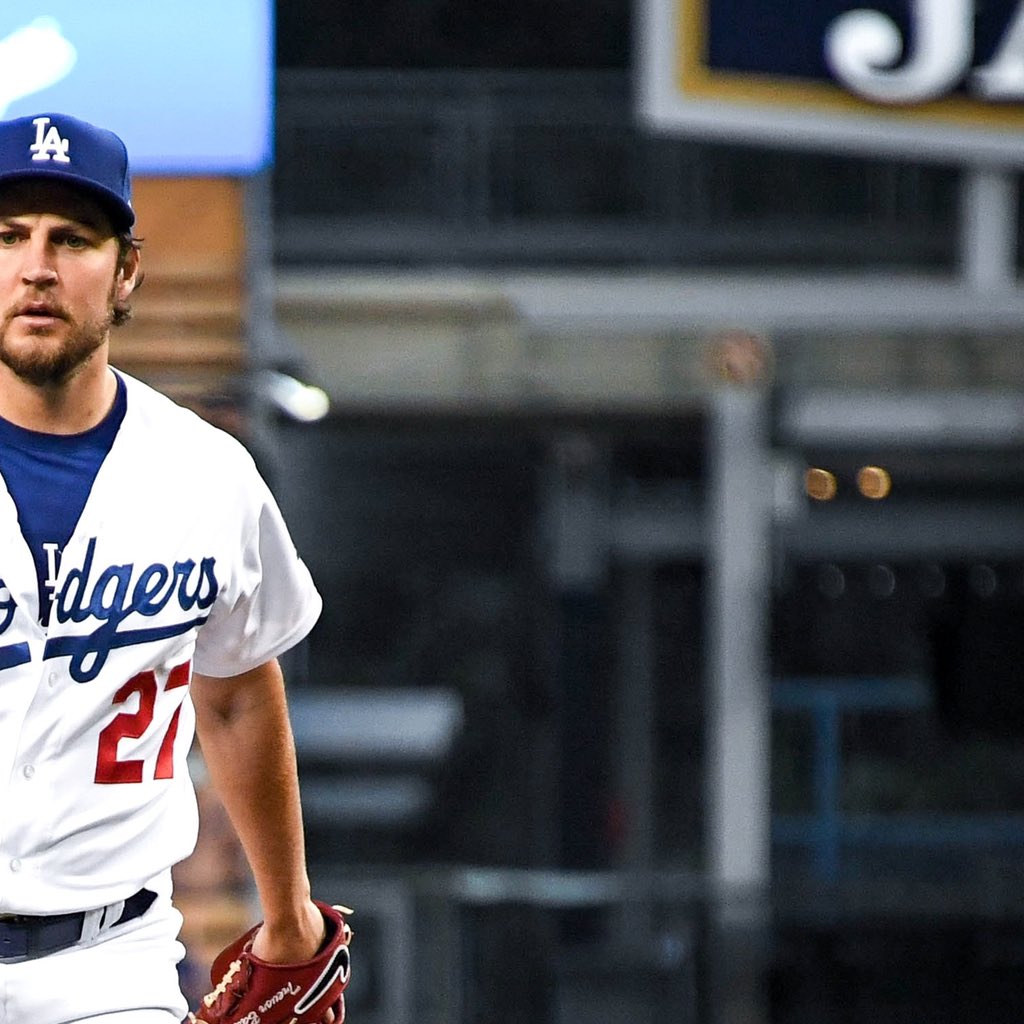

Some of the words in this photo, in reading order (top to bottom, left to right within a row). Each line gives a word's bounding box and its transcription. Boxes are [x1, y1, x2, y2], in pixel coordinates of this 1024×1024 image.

[30, 117, 70, 163] LA
[94, 659, 191, 784] 27
[258, 981, 302, 1013] Trevor
